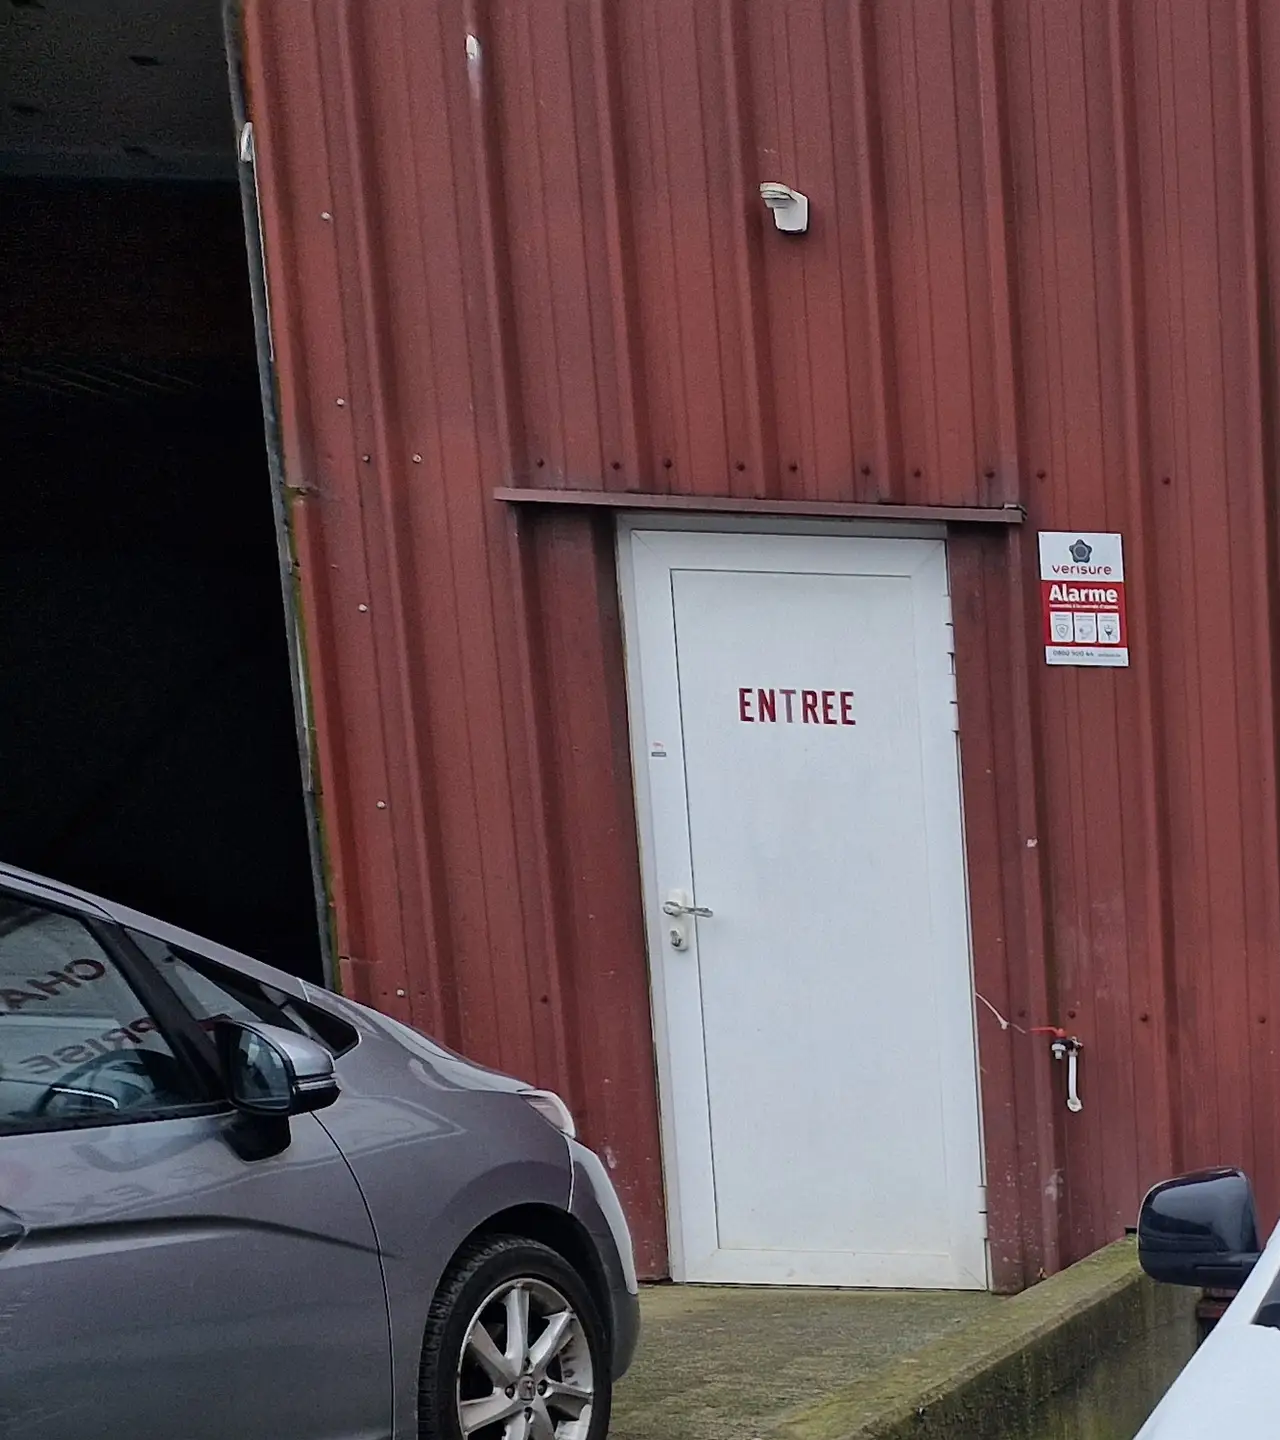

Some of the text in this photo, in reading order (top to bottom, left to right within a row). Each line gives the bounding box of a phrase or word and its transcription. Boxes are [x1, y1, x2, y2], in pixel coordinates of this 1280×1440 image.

[1051, 564, 1112, 576] verisure
[1049, 583, 1118, 603] Alarme
[738, 687, 857, 726] ENTREE
